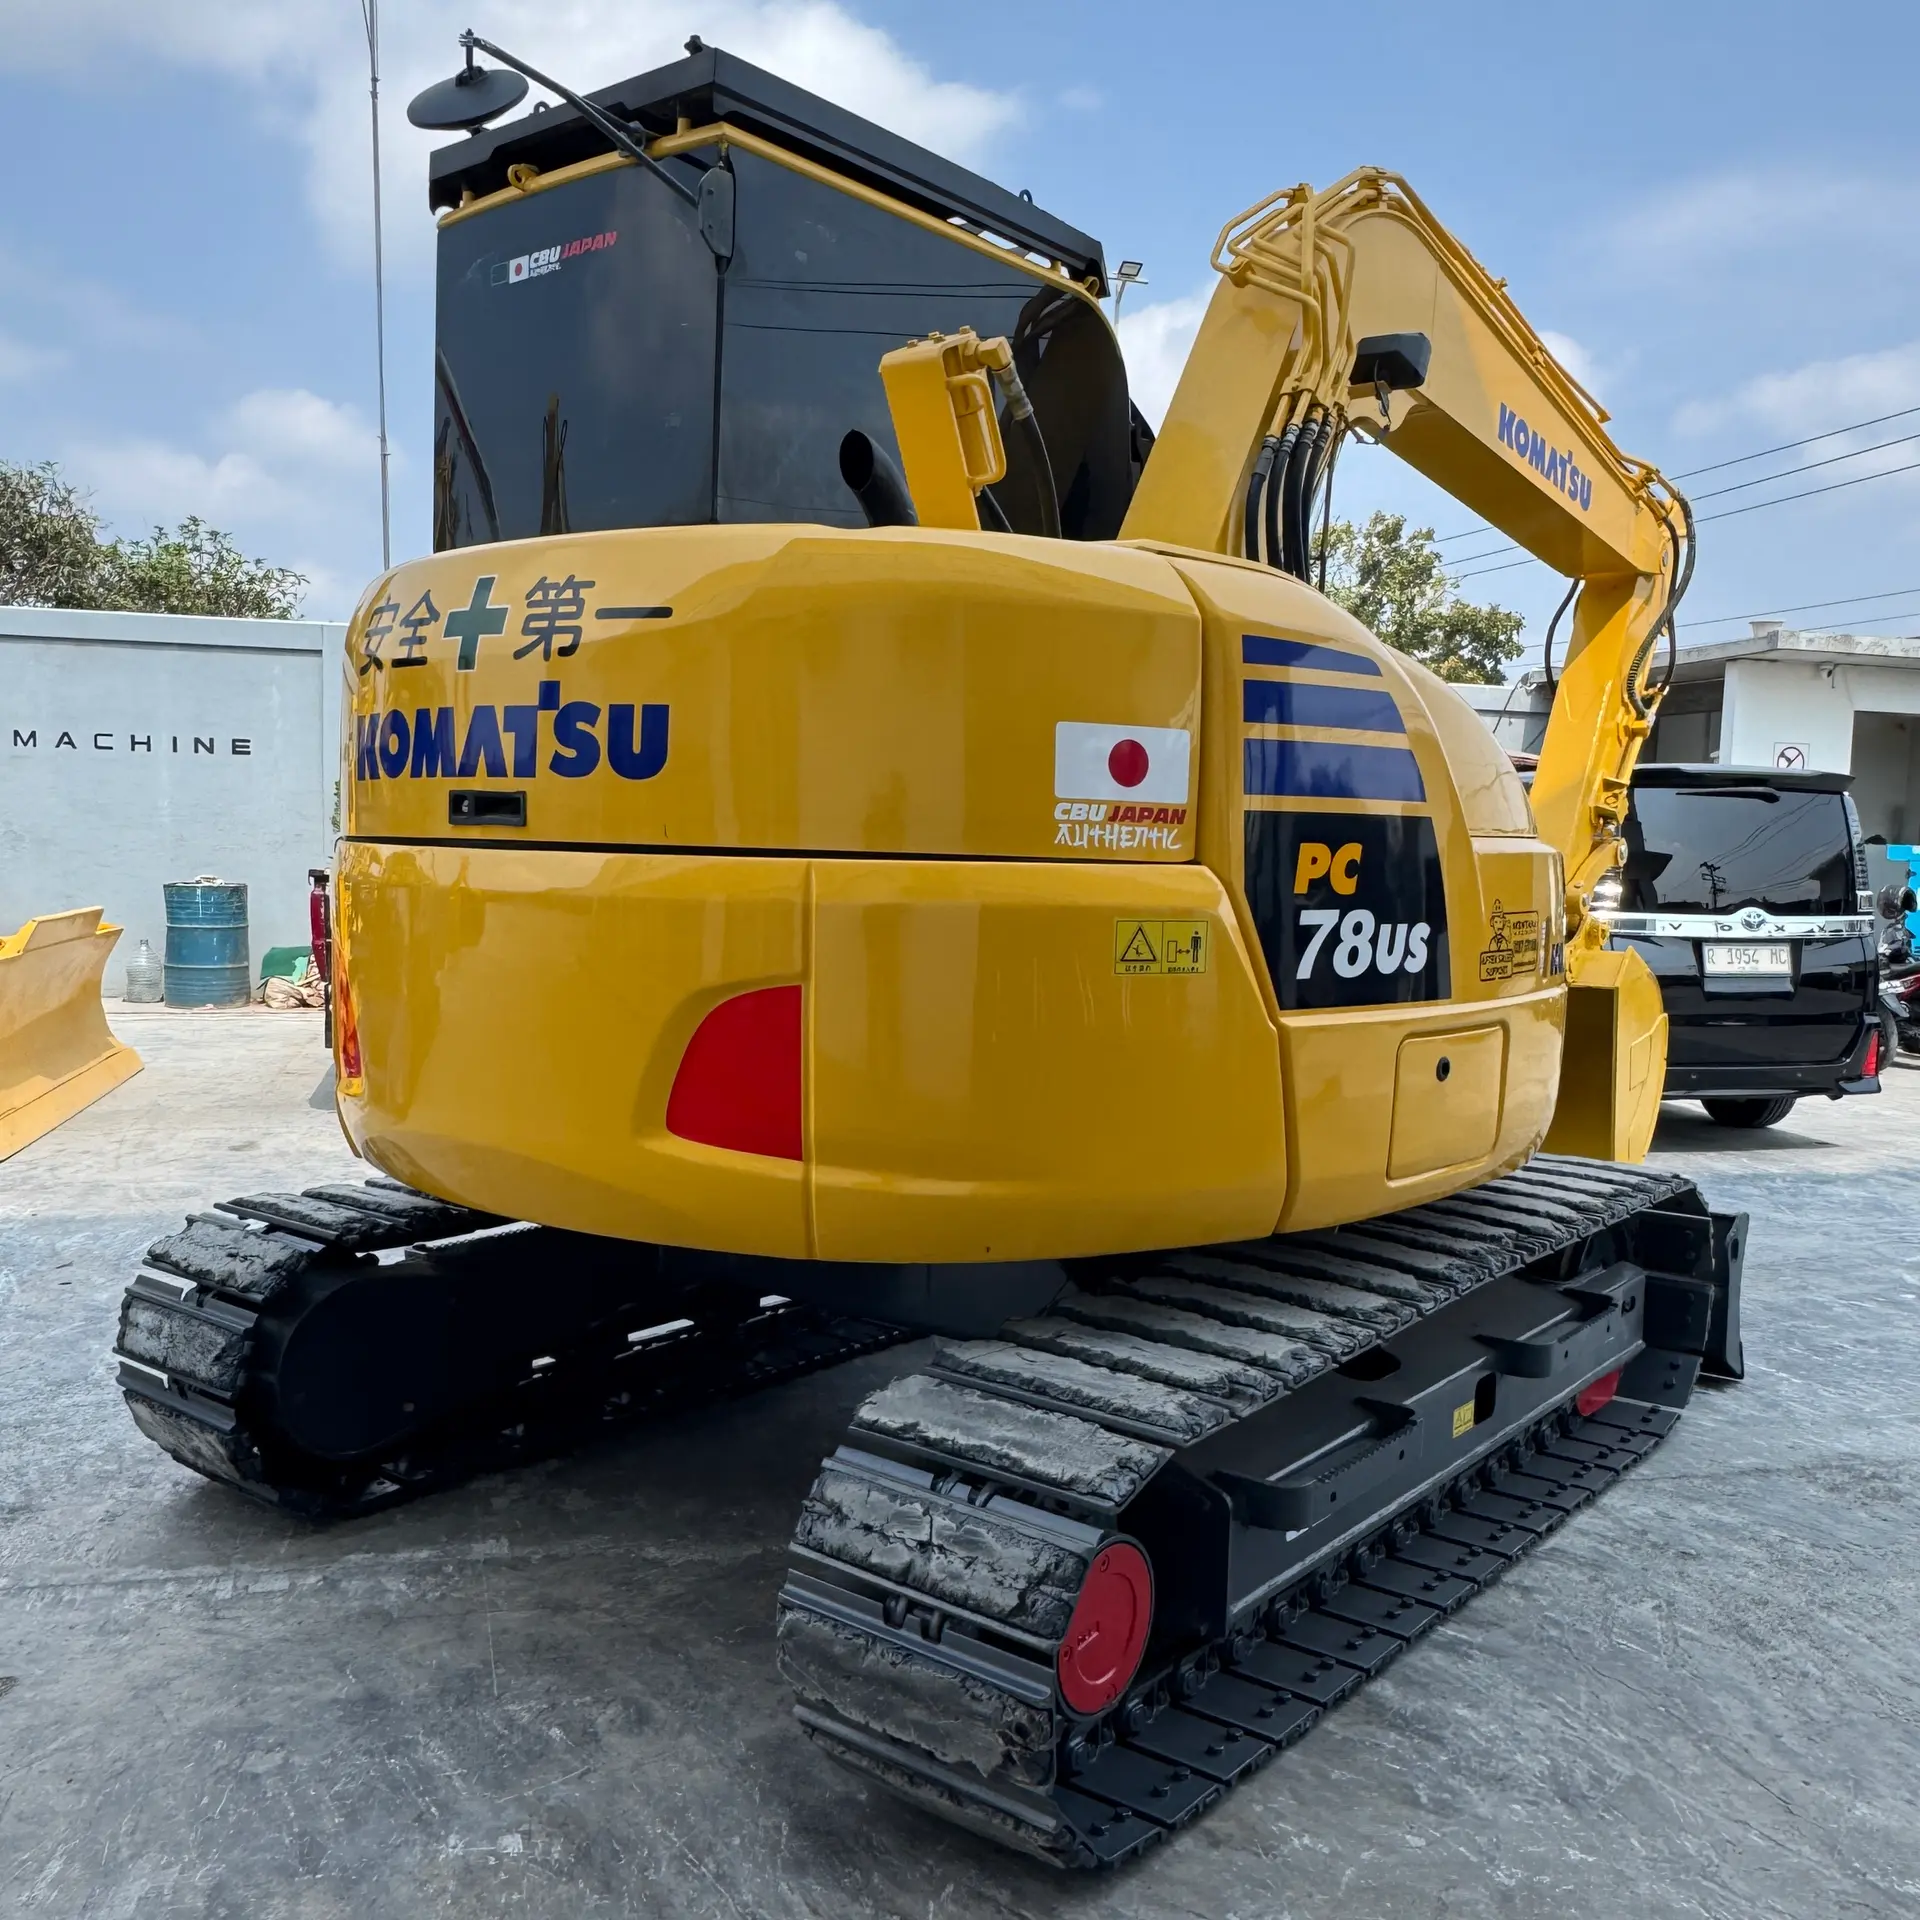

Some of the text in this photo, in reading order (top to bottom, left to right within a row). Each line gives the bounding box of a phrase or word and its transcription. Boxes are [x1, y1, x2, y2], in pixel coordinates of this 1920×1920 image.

[530, 231, 617, 268] CBU JAPAN
[1498, 402, 1592, 511] KOMATSU
[359, 574, 673, 676] 安全 第一
[13, 729, 251, 755] MACHINE
[357, 680, 670, 781] KOMATSU
[1054, 802, 1187, 825] CBU JAPAN
[1054, 823, 1182, 850] AUTHENTIC
[1294, 842, 1363, 895] PC
